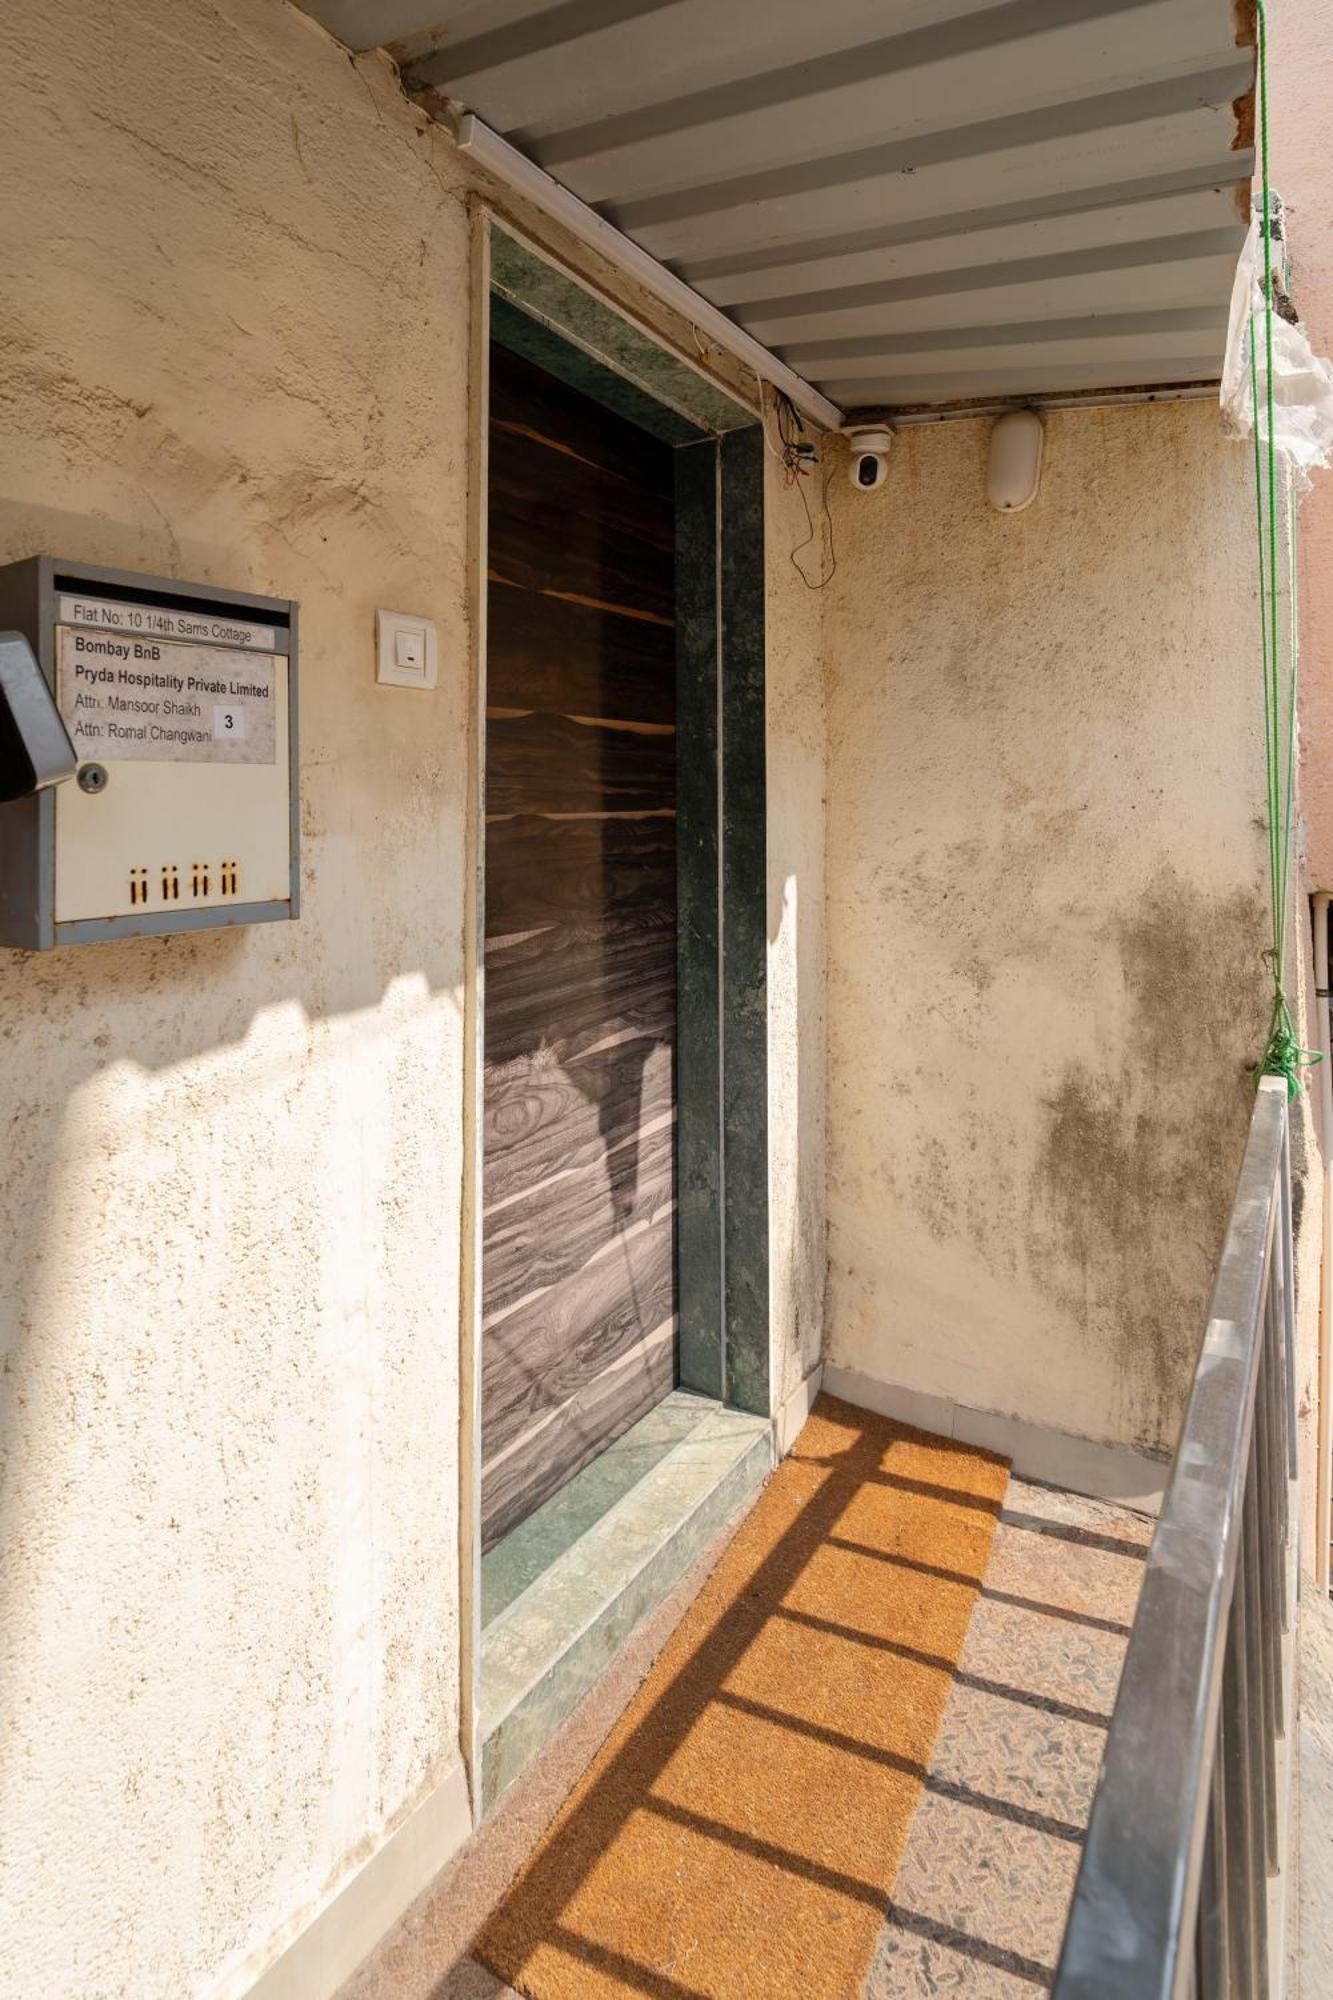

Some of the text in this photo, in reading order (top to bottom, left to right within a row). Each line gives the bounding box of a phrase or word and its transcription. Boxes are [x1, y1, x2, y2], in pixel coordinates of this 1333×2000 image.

[74, 604, 98, 620] Flat
[102, 609, 124, 625] No:
[128, 613, 142, 627] 10
[178, 620, 209, 637] Sams
[212, 624, 252, 644] Cottage
[75, 637, 161, 660] Bombay BnB
[75, 665, 269, 698] Pryda Hospitality Private Limited
[108, 696, 160, 714] Mansoor
[163, 701, 201, 717] Shaikh
[224, 715, 233, 728] 3
[75, 722, 212, 745] Attn: Romal Changwani
